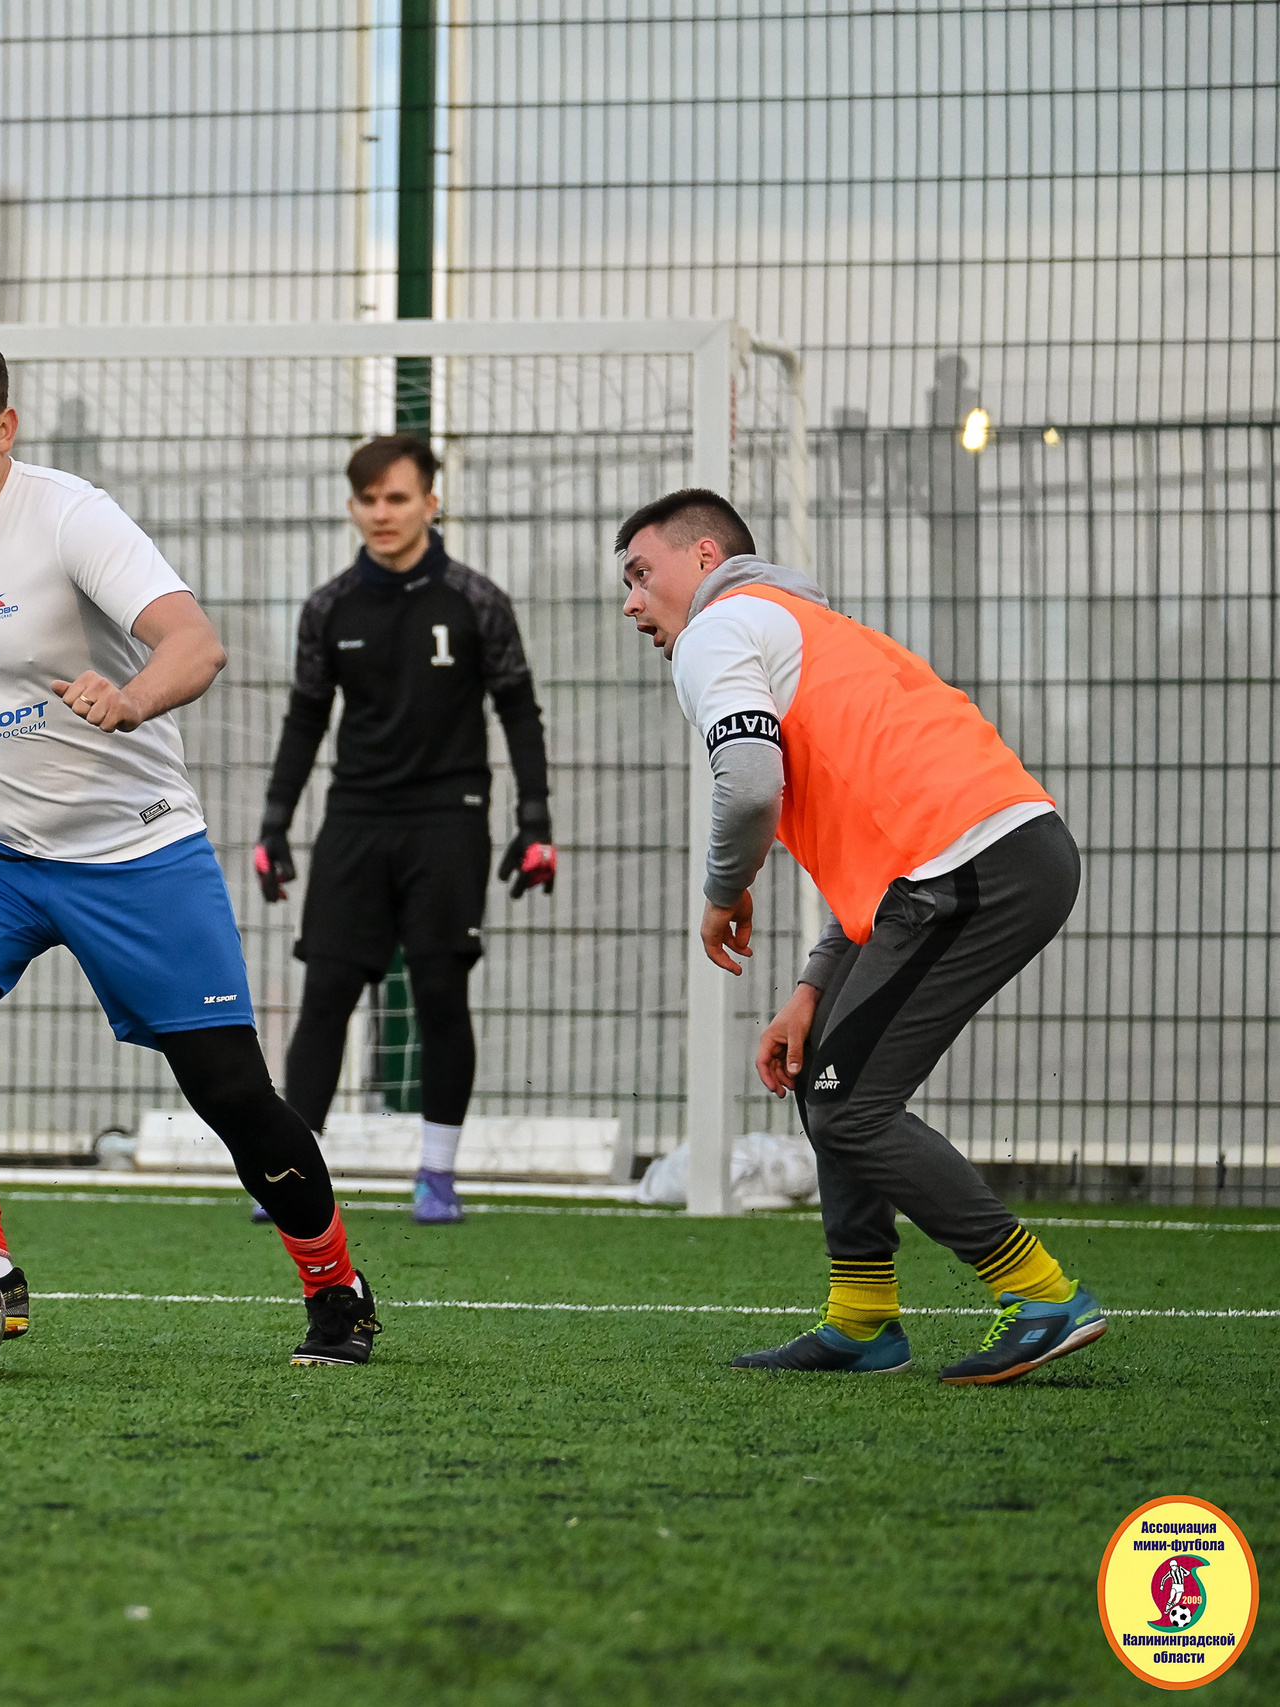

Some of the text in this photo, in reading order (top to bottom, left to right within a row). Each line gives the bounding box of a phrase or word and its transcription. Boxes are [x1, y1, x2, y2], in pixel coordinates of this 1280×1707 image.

[431, 624, 455, 666] 1
[216, 994, 238, 1003] SPORT
[814, 1080, 841, 1090] SPORT
